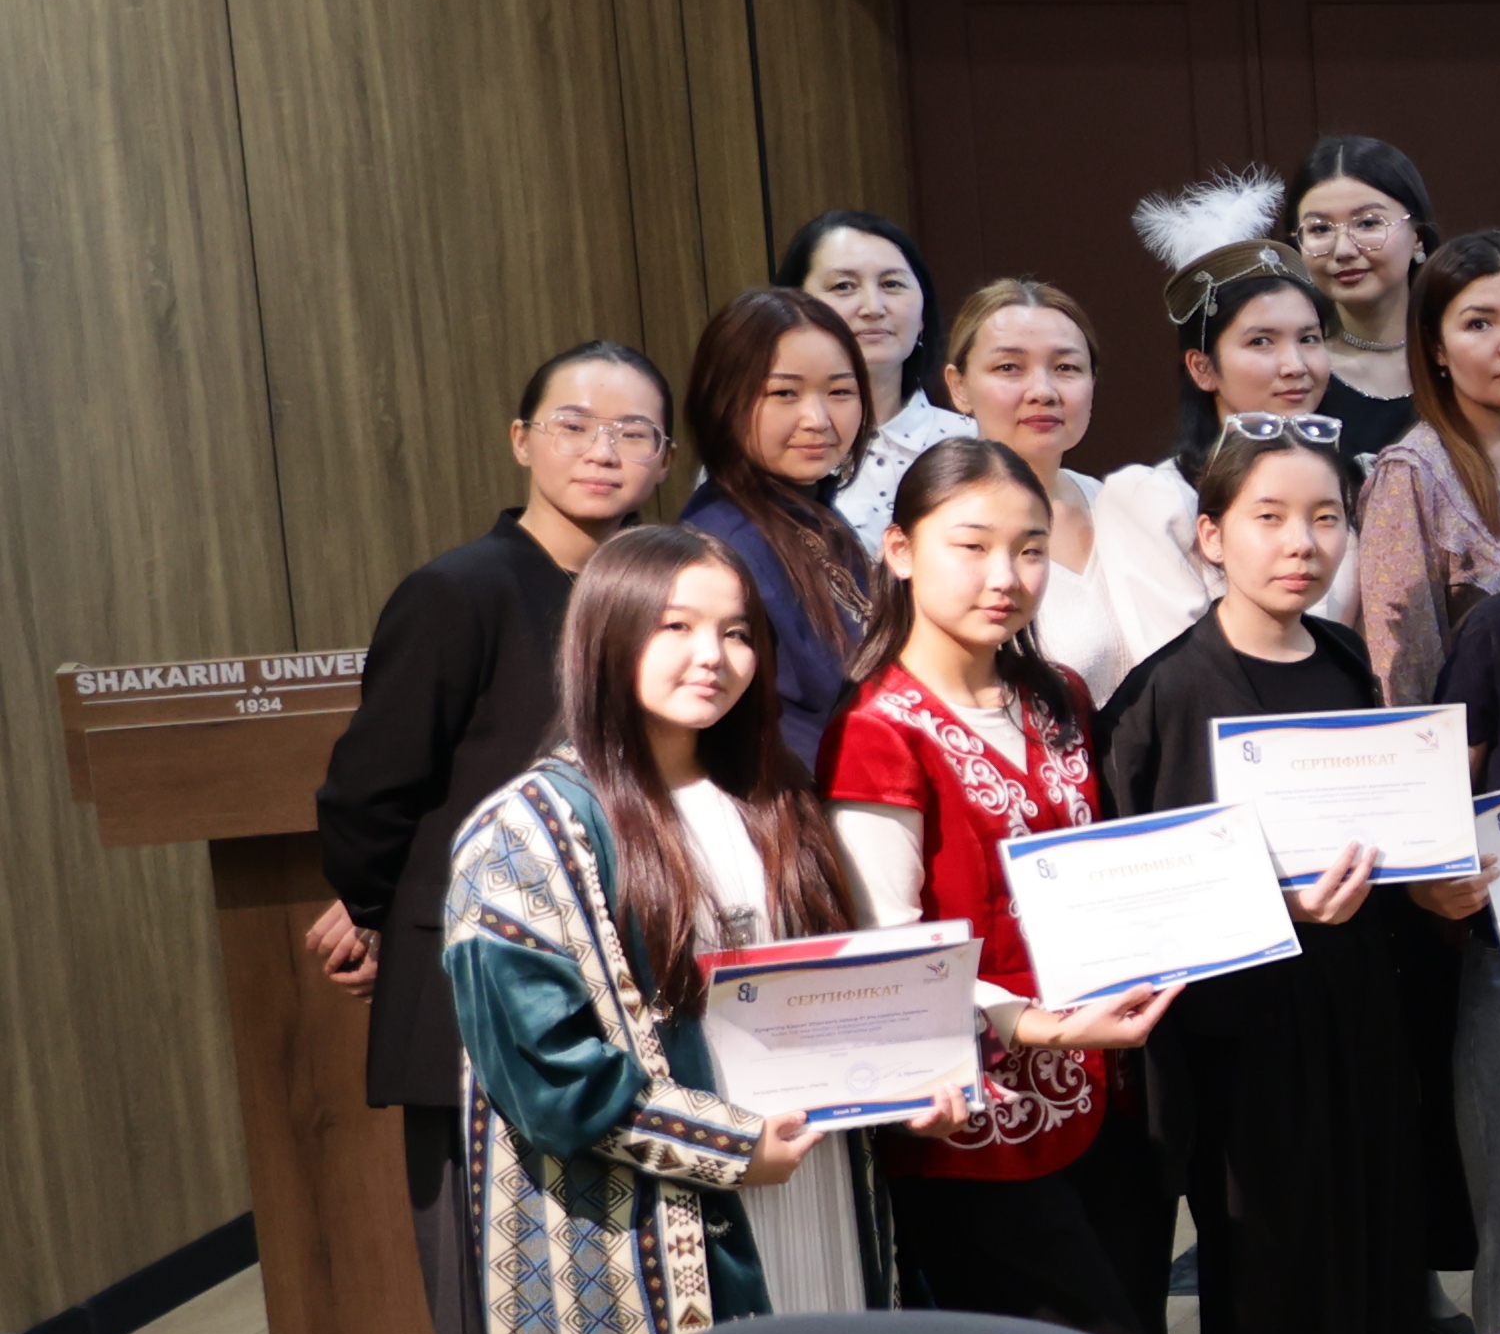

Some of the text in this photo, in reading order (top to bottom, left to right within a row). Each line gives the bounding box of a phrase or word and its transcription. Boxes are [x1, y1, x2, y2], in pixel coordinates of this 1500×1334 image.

[75, 662, 245, 695] SHAKARIM
[235, 697, 283, 714] 1934
[1290, 753, 1398, 771] СЕРТИФИКАТ
[787, 984, 903, 1007] СЕРТИФИКАТ
